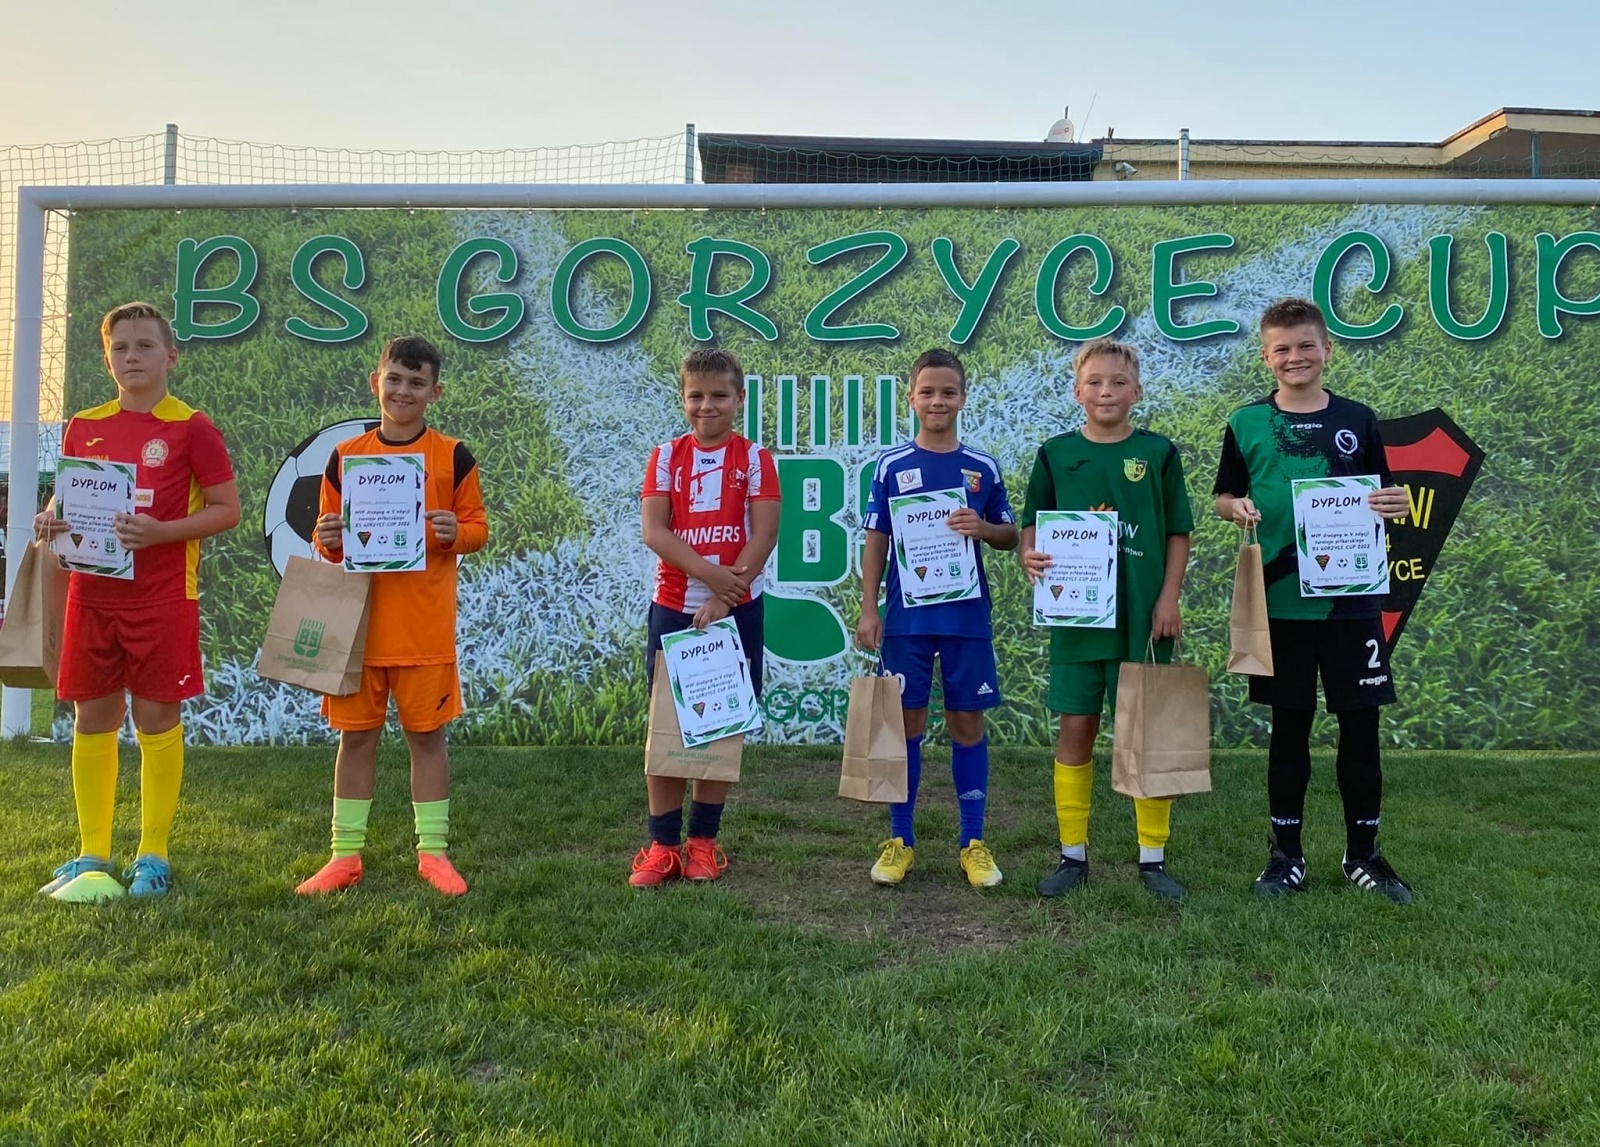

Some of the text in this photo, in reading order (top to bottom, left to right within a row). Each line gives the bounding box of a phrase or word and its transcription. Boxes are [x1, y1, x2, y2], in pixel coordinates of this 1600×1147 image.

[170, 228, 1600, 345] BS GORZYCE CUP
[1290, 422, 1323, 430] regio
[71, 478, 117, 492] DYPLOM
[358, 473, 405, 485] DYPLOM
[1311, 495, 1361, 508] DYPLOM
[907, 508, 950, 523] DYPLOM
[1052, 530, 1098, 539] DYPLOM
[299, 628, 320, 648] BS
[681, 640, 724, 660] DYPLOM
[1365, 639, 1381, 668] 2
[1359, 675, 1388, 686] regio
